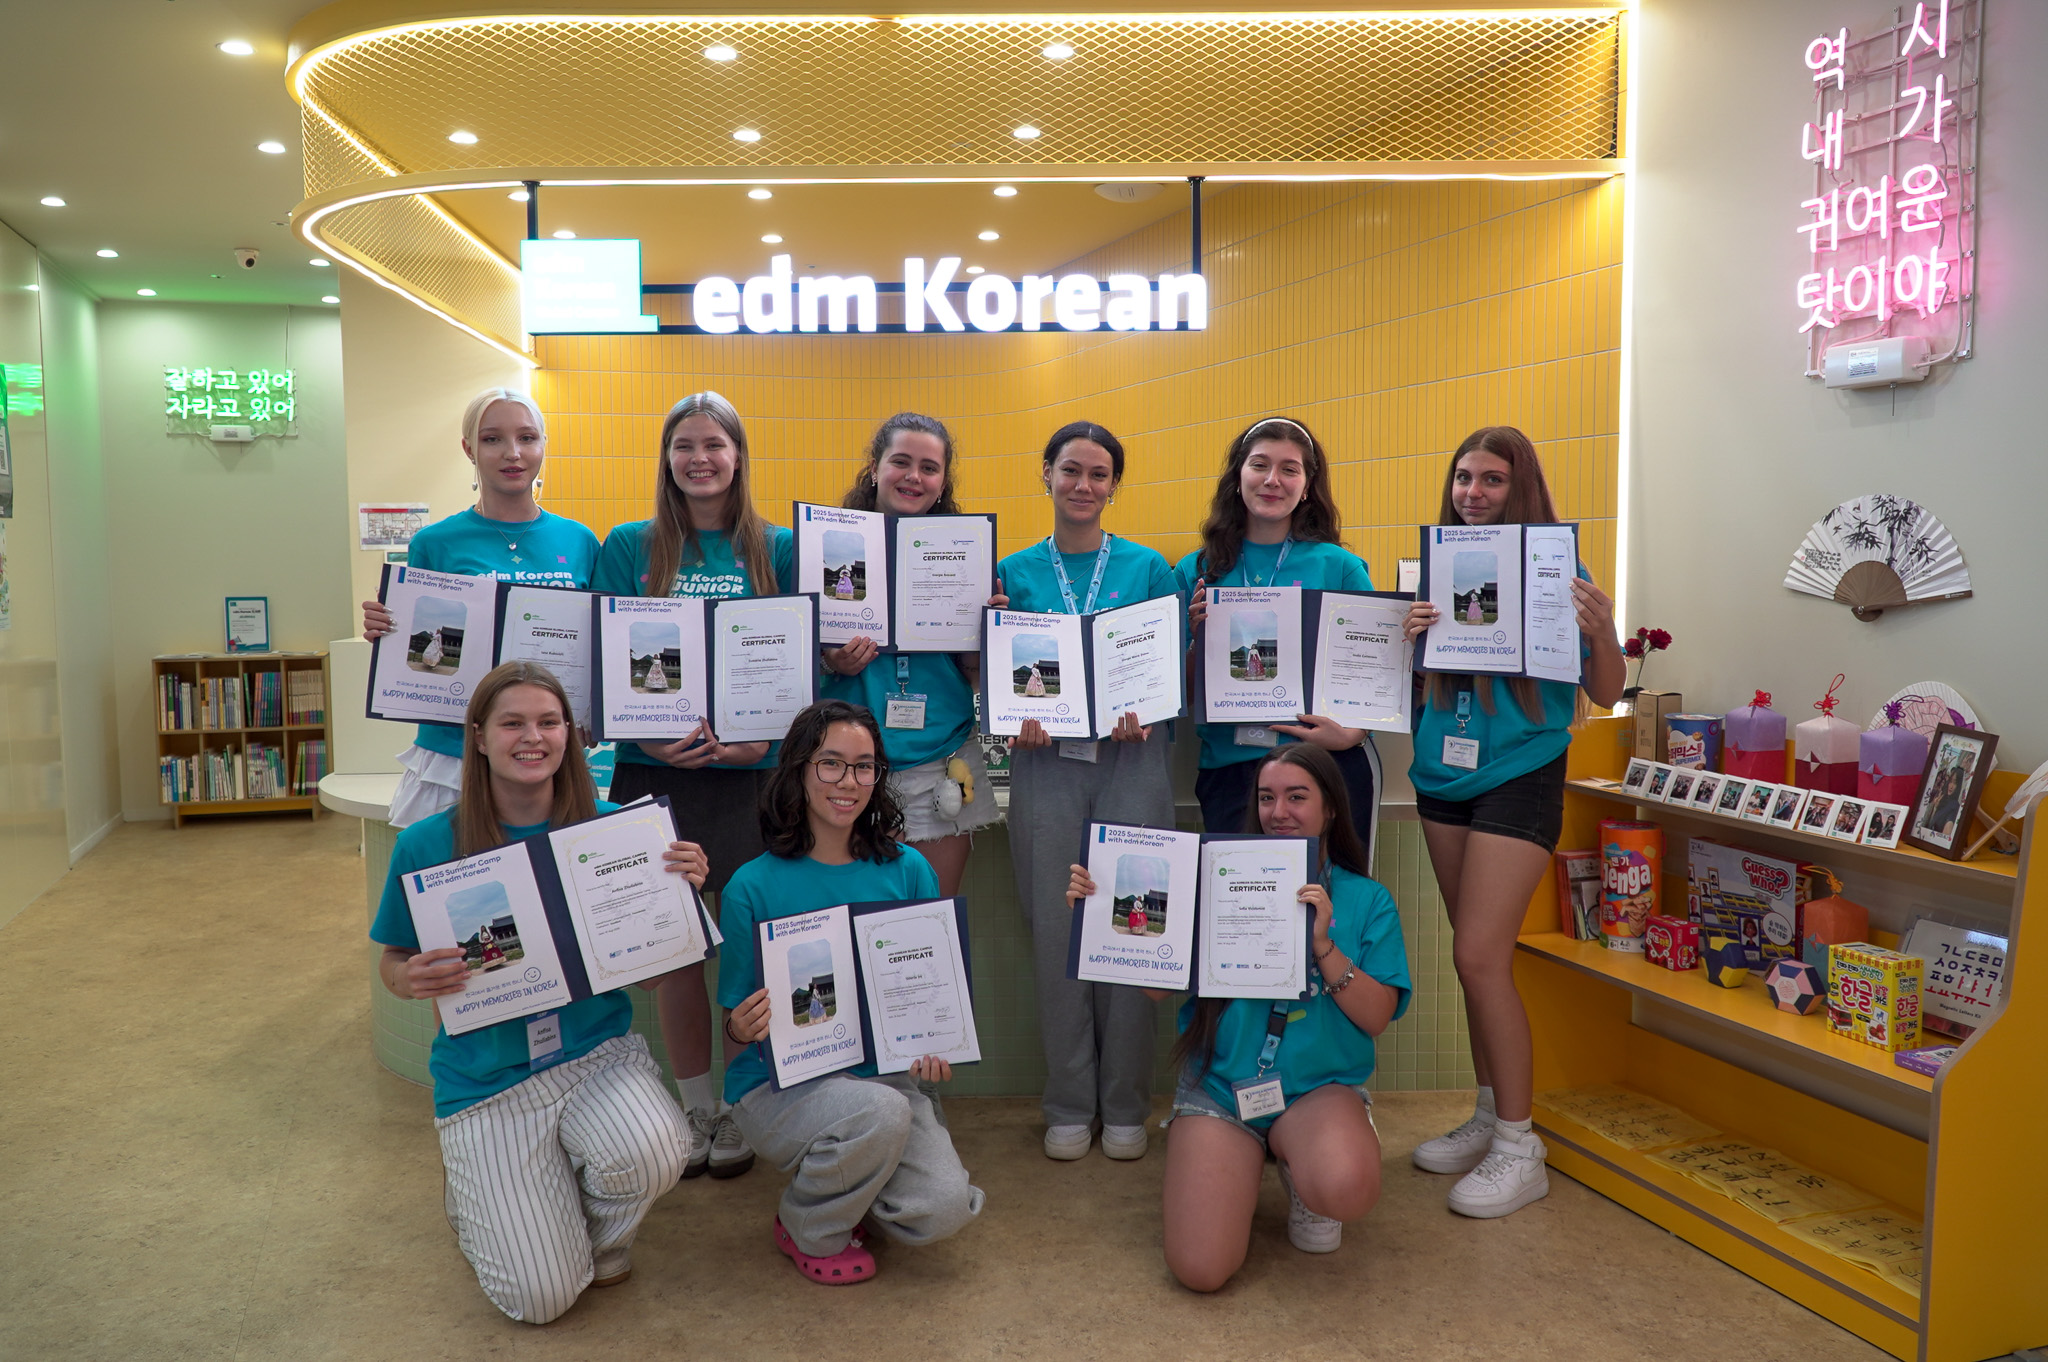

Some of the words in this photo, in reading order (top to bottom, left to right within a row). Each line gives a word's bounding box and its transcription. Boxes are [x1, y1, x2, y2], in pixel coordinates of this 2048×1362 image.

[1797, 163, 1949, 252] 귀여운
[692, 255, 876, 334] edm
[904, 256, 1208, 333] Korean
[1797, 246, 1950, 333] 탓이야
[165, 366, 240, 392] 잘하고
[248, 368, 294, 394] 있어
[165, 394, 242, 420] 자라고
[249, 396, 295, 422] 있어
[408, 570, 425, 580] 2025
[454, 578, 474, 588] Camp
[515, 571, 572, 580] Korean
[691, 574, 743, 584] Korean
[672, 582, 744, 594] JUNIOR
[532, 631, 578, 640] CERTIFICATE
[741, 638, 786, 646] CERTIFICATE
[1116, 634, 1156, 648] CERTIFICATE
[1345, 634, 1388, 644] CERTIFICATE
[382, 688, 405, 700] HAPPY
[406, 692, 442, 704] MEMORIES
[443, 696, 450, 706] IN
[452, 696, 469, 707] KORE
[635, 714, 670, 722] MEMORIES
[672, 714, 678, 723] IN
[1108, 830, 1126, 838] 2025
[1156, 834, 1176, 842] Camp
[424, 870, 444, 882] 2025
[444, 862, 477, 876] Summer
[478, 855, 502, 866] Camp
[595, 856, 648, 876] CERTIFICATE
[1742, 859, 1776, 879] Guess
[426, 880, 444, 890] with
[444, 874, 462, 884] edm
[462, 866, 490, 880] Korean
[1602, 863, 1651, 895] Jenga
[888, 951, 934, 964] CERTIFICATE
[1089, 954, 1112, 964] HAPPY
[1113, 957, 1150, 968] MEMORIES
[1152, 960, 1160, 970] IN
[1160, 962, 1184, 972] KOREA
[454, 1002, 480, 1015] HAPPY
[481, 990, 522, 1008] MEMORIES
[522, 987, 532, 996] IN
[533, 979, 558, 993] KOREA
[1840, 974, 1874, 1014] 한글
[1896, 994, 1919, 1018] 한글
[801, 1045, 830, 1062] MEMORIES
[830, 1044, 838, 1053] IN
